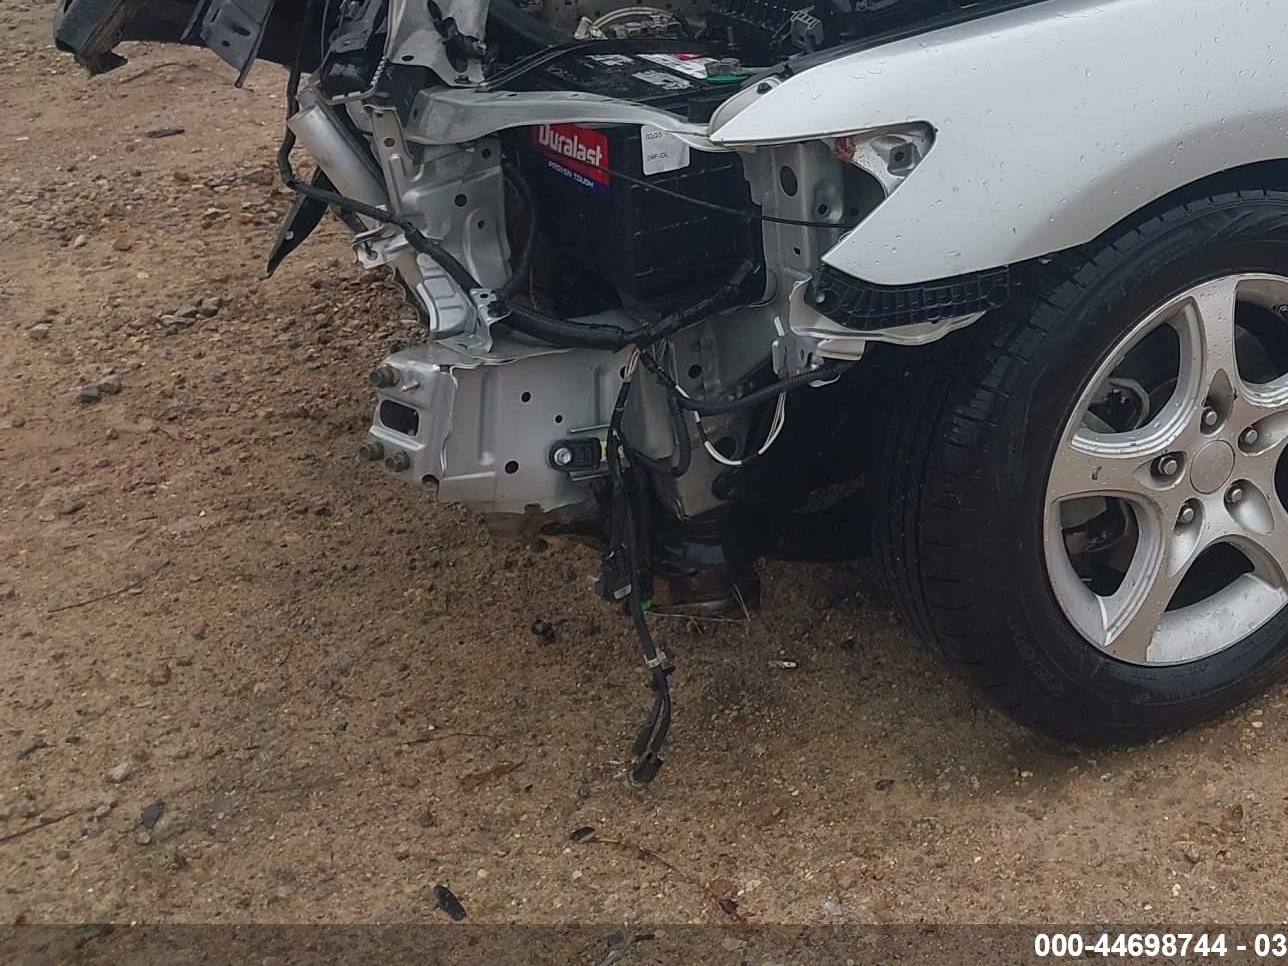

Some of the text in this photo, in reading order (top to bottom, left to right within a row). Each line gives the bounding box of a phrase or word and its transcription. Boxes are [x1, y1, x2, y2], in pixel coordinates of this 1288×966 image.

[538, 125, 603, 167] Duralast
[547, 161, 595, 189] PROVEN TOUGH
